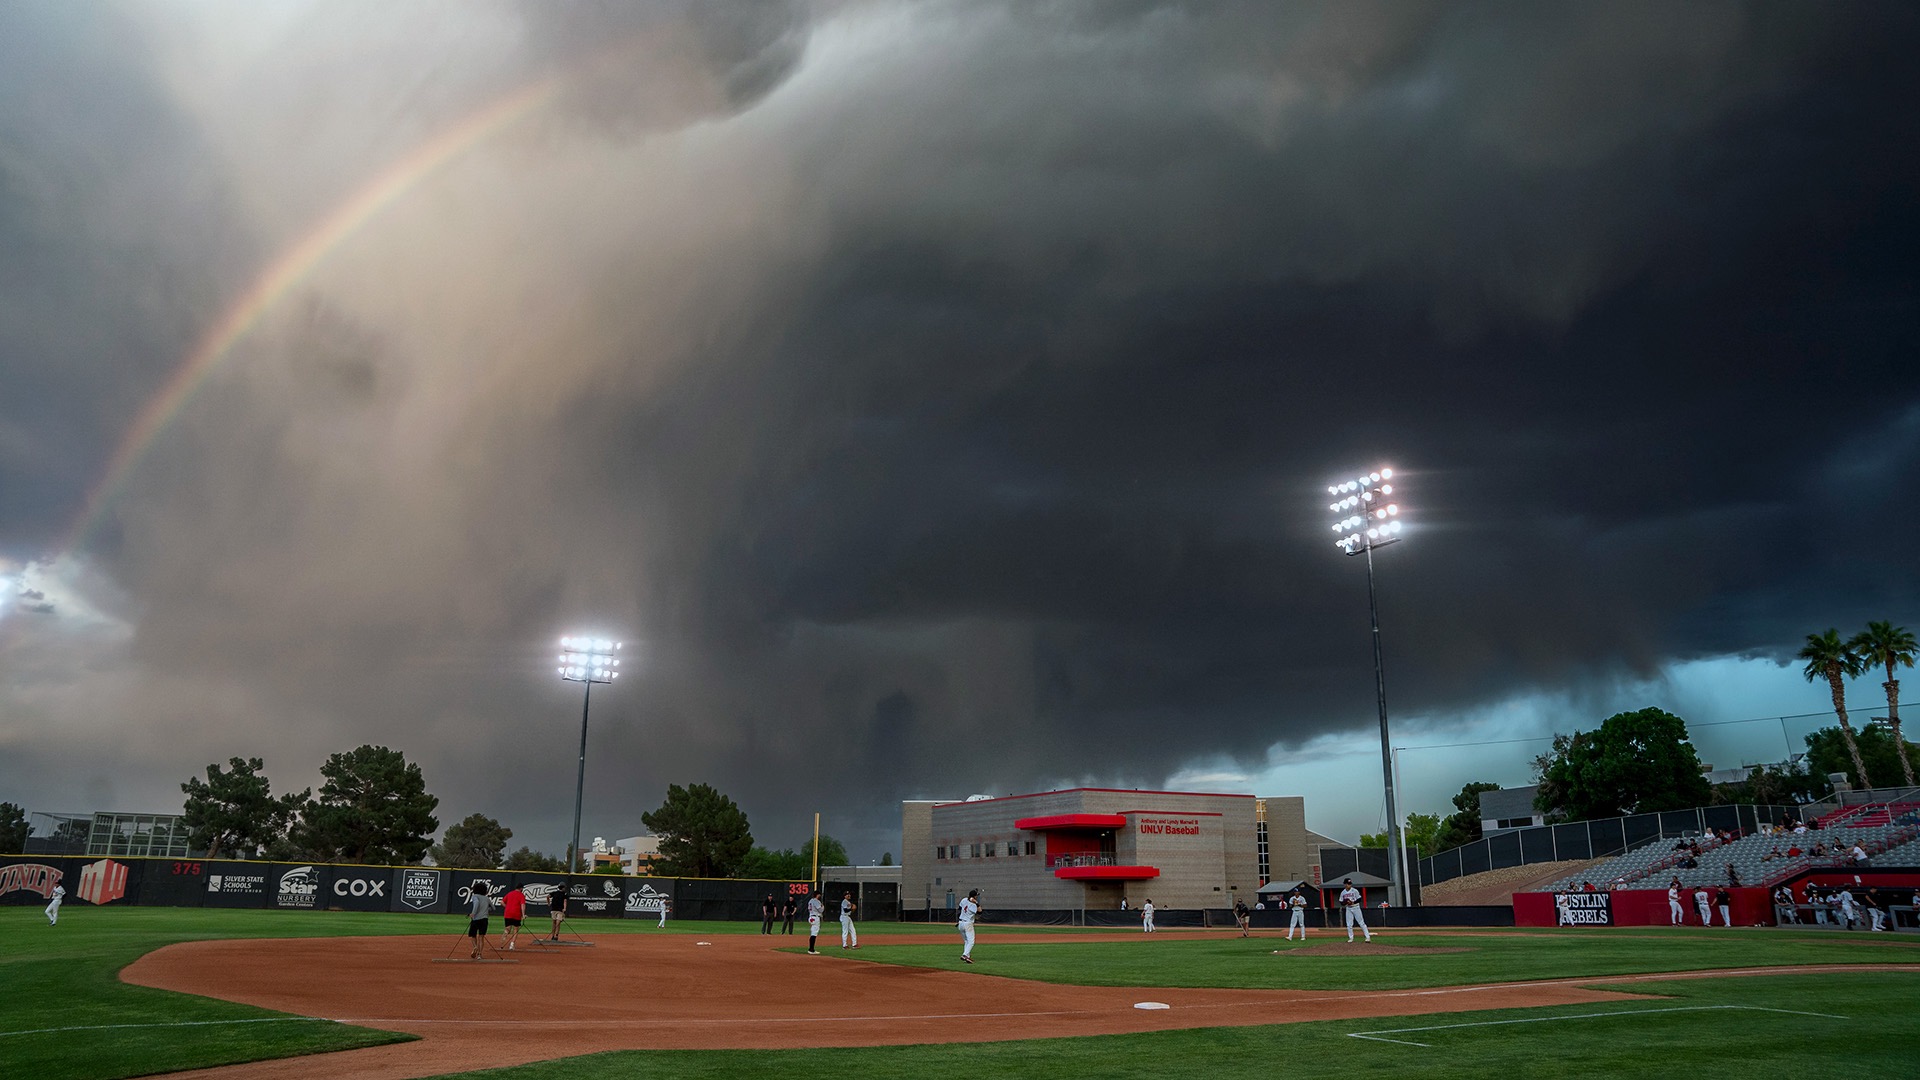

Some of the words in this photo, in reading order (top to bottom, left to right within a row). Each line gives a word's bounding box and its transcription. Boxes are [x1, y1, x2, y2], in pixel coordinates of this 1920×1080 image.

[1141, 825, 1163, 834] UNLV
[1165, 826, 1199, 835] Baseball
[172, 863, 201, 875] 375
[0, 863, 64, 899] UNLV
[279, 880, 318, 894] Star
[407, 878, 434, 886] ARMY
[334, 879, 385, 897] COX
[789, 884, 808, 895] 335
[625, 893, 662, 908] SIERR
